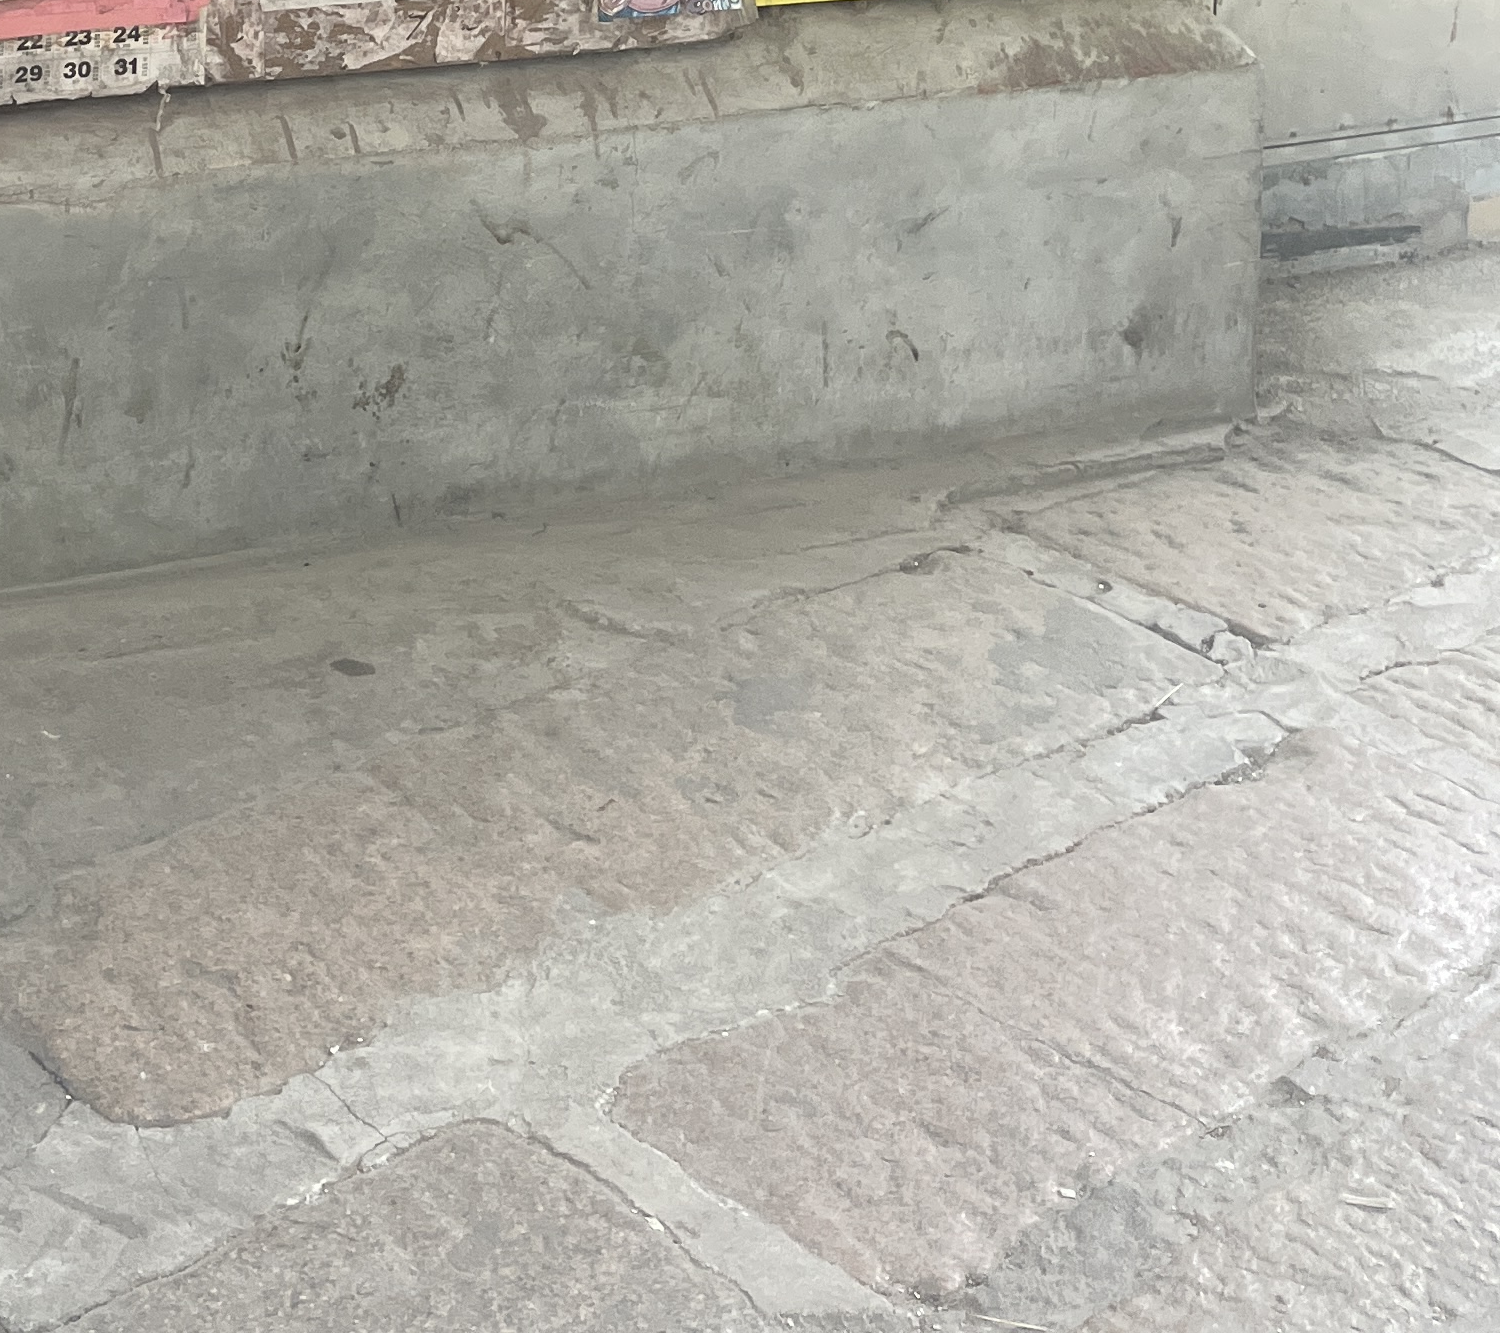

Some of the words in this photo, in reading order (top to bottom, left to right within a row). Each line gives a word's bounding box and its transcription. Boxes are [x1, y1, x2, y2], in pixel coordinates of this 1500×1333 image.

[112, 25, 142, 45] 24
[14, 64, 43, 84] 29
[62, 60, 92, 80] 30
[113, 57, 139, 77] 31
